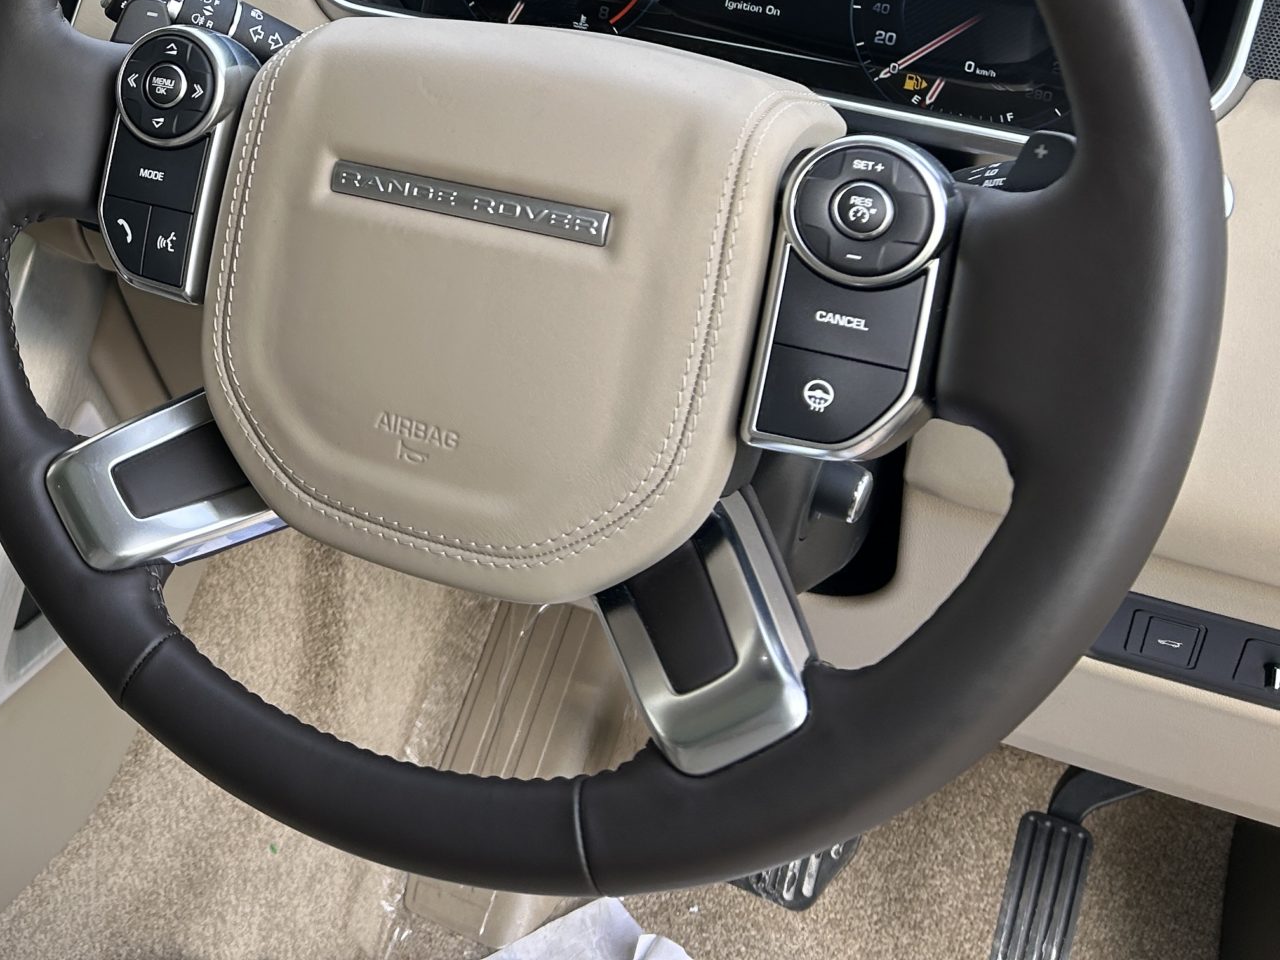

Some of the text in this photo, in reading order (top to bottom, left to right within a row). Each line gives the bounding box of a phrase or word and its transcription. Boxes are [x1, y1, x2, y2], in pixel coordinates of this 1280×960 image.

[598, 5, 610, 20] 8
[765, 4, 781, 17] On
[872, 2, 891, 15] 40
[873, 29, 897, 46] 20
[888, 62, 900, 75] 0
[964, 59, 997, 79] 0 km/h
[151, 76, 176, 88] MENU
[155, 86, 168, 96] OK
[911, 94, 922, 106] E
[1005, 112, 1015, 123] F
[138, 167, 165, 182] MODE
[983, 168, 1000, 177] LO
[341, 171, 599, 235] RANGE ROVER
[849, 195, 873, 209] RES
[814, 309, 870, 332] CANCEL
[373, 410, 460, 451] AIRBAG
